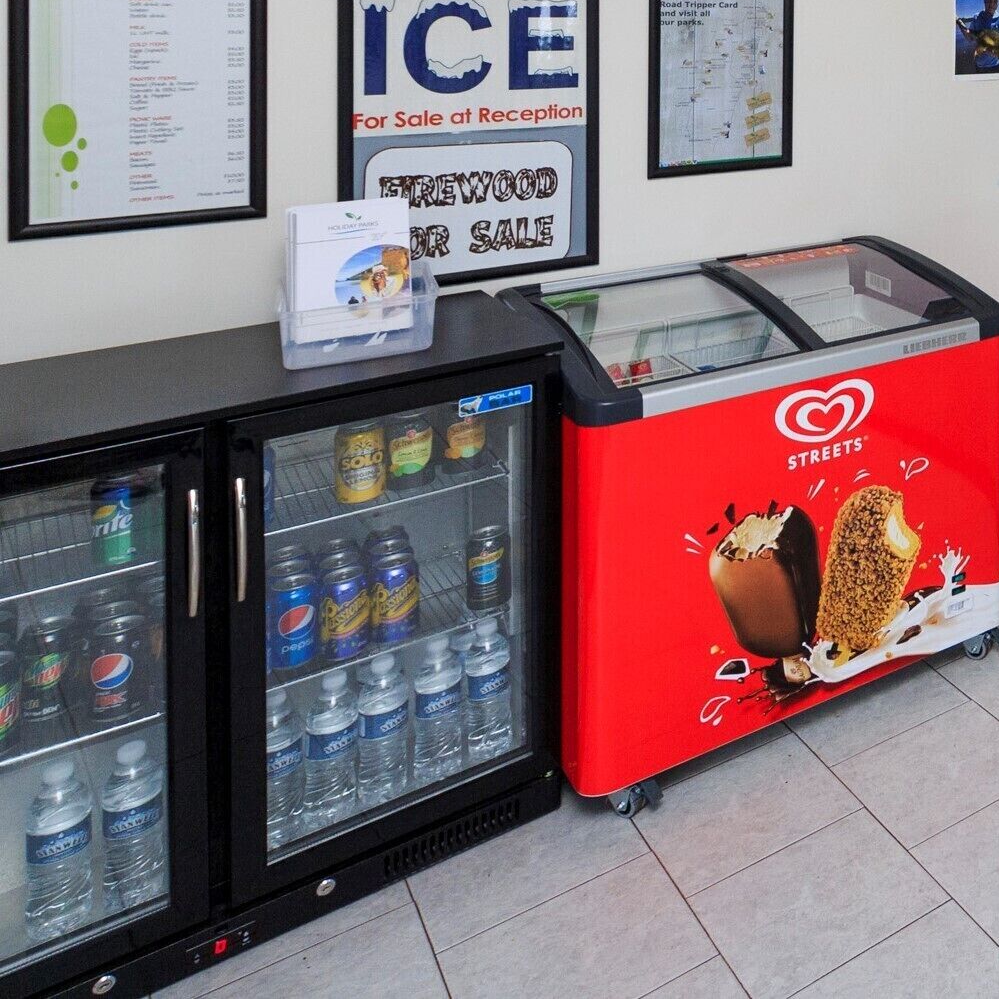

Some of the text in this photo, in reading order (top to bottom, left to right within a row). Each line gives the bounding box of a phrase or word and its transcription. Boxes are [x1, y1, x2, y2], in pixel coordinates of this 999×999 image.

[685, 1, 716, 9] Tripper
[677, 19, 704, 27] parks.
[352, 104, 584, 130] For Sale at Reception
[379, 167, 558, 209] FIREWOOD
[328, 220, 379, 231] HOLIDAY PARKS
[409, 214, 554, 261] OR SALE
[903, 332, 967, 355] LIEBHERR
[489, 389, 521, 401] POLAR
[341, 450, 384, 471] SOLO
[787, 437, 863, 471] STREETS
[93, 509, 134, 538] rite
[281, 638, 314, 655] pepsi
